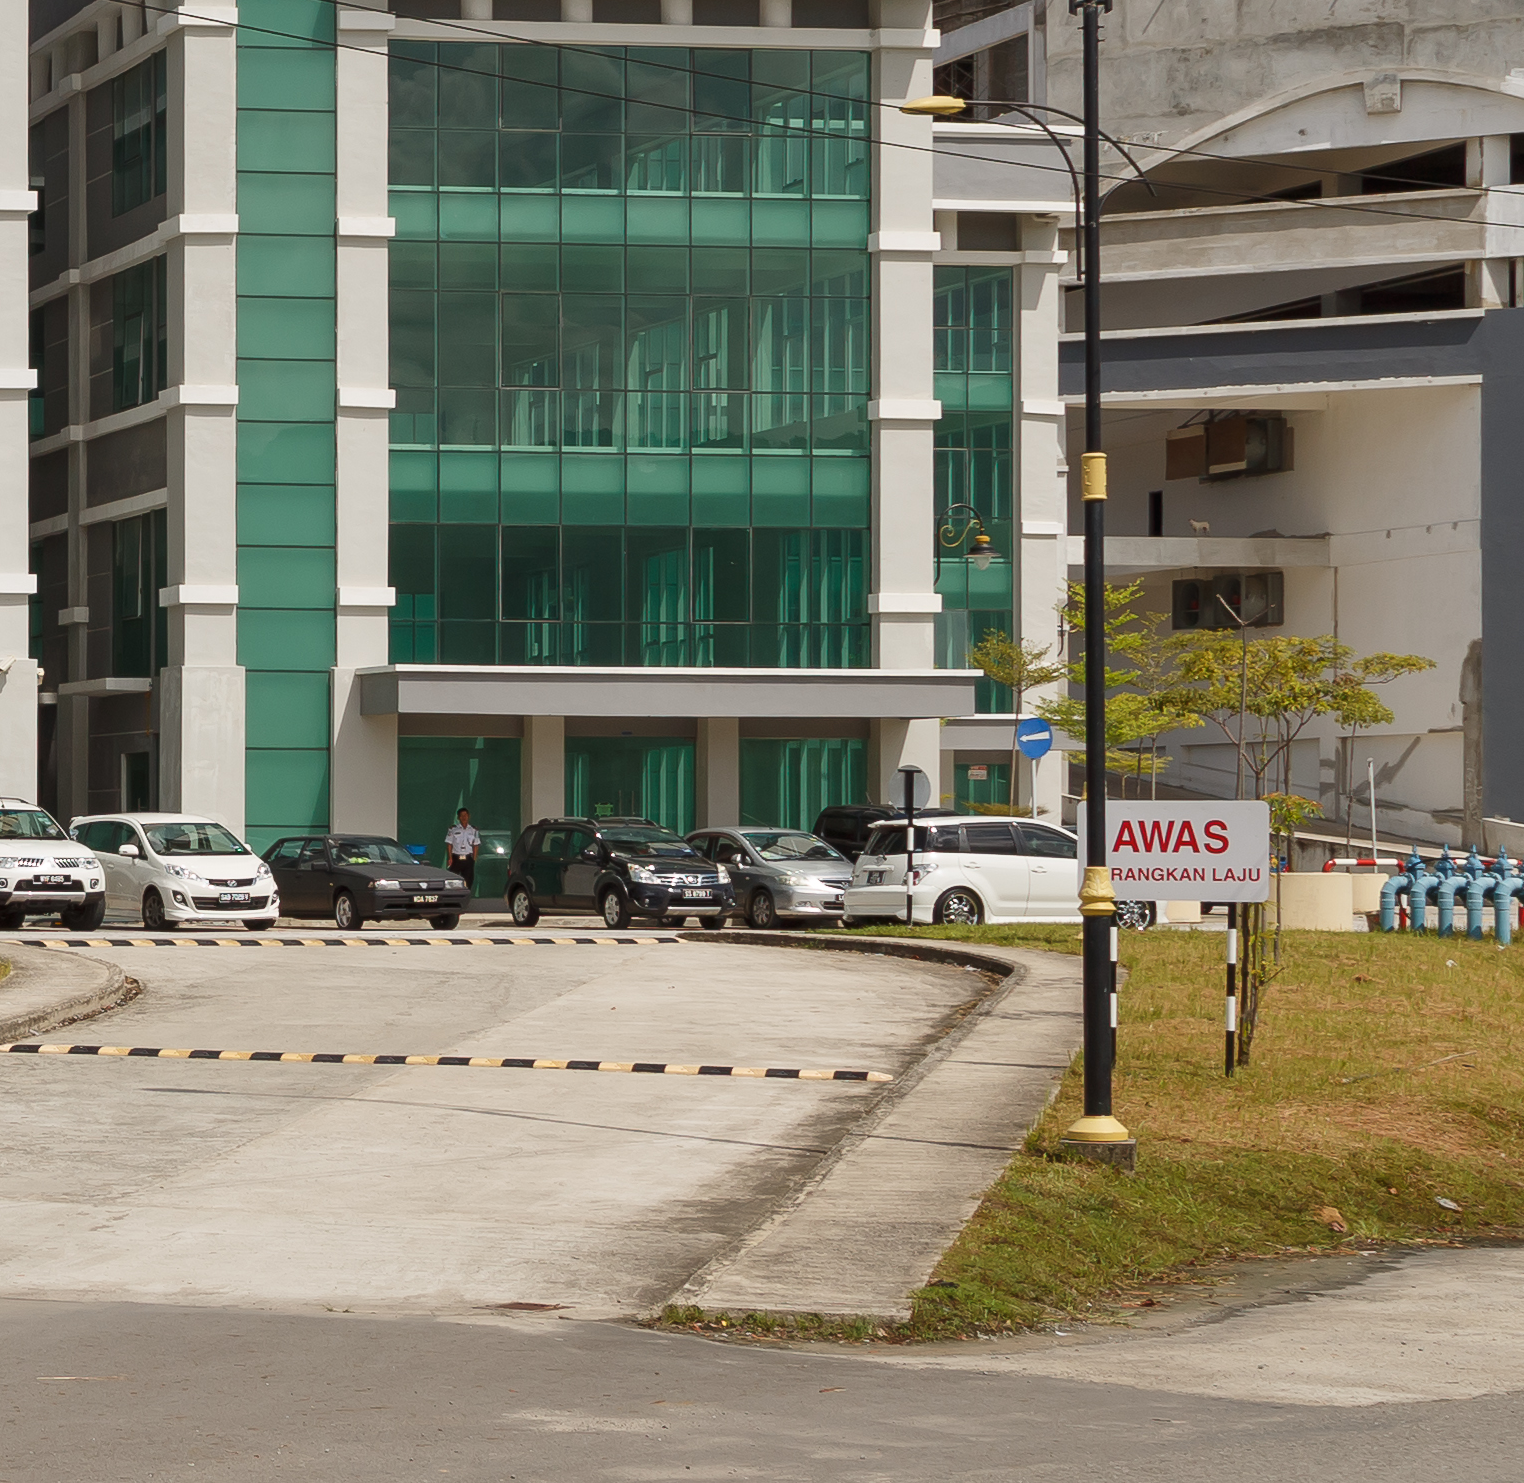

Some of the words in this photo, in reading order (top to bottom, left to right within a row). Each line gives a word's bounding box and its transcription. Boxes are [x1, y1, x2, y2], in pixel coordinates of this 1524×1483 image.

[1112, 820, 1230, 854] AWAS
[1111, 867, 1205, 881] RANGKAN
[1212, 868, 1261, 881] LAJU
